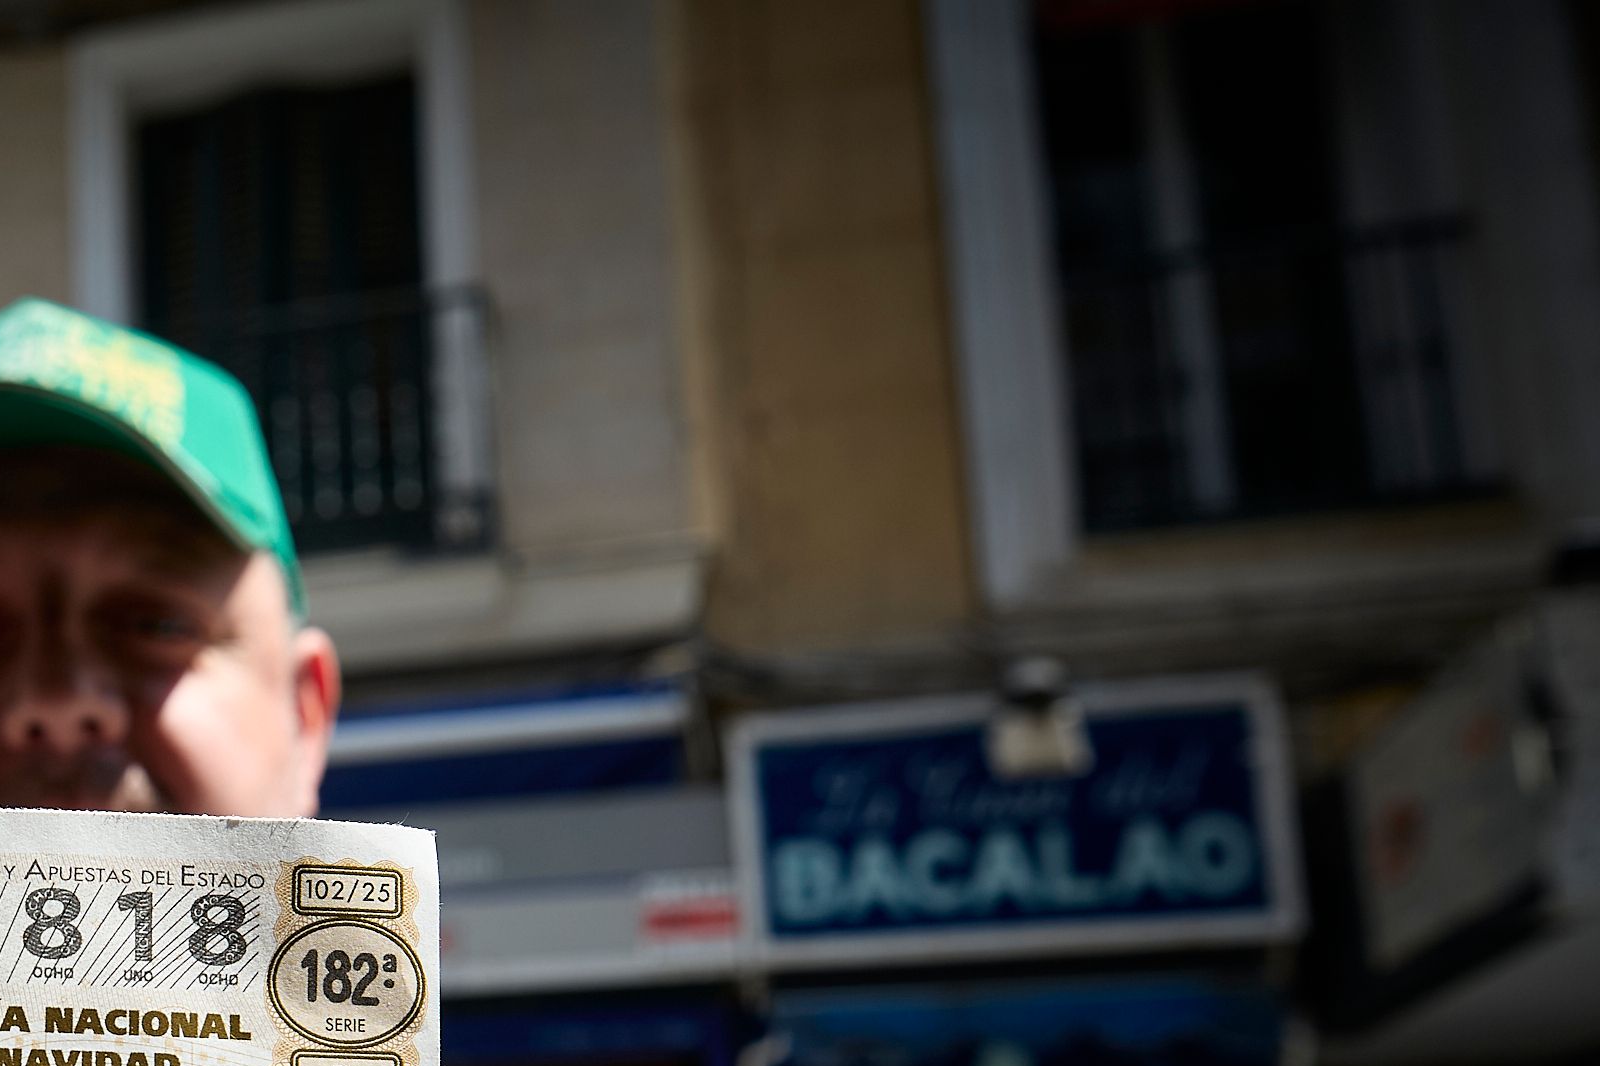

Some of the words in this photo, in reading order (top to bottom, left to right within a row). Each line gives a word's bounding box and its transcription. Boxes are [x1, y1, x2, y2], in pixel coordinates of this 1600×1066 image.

[773, 811, 1258, 921] BACALAO
[305, 879, 390, 903] 102/25
[33, 966, 74, 979] OCHO
[124, 969, 153, 982] UNO
[200, 972, 239, 985] OCHO
[45, 1007, 251, 1040] NACIONAL
[325, 1017, 366, 1033] SERIE
